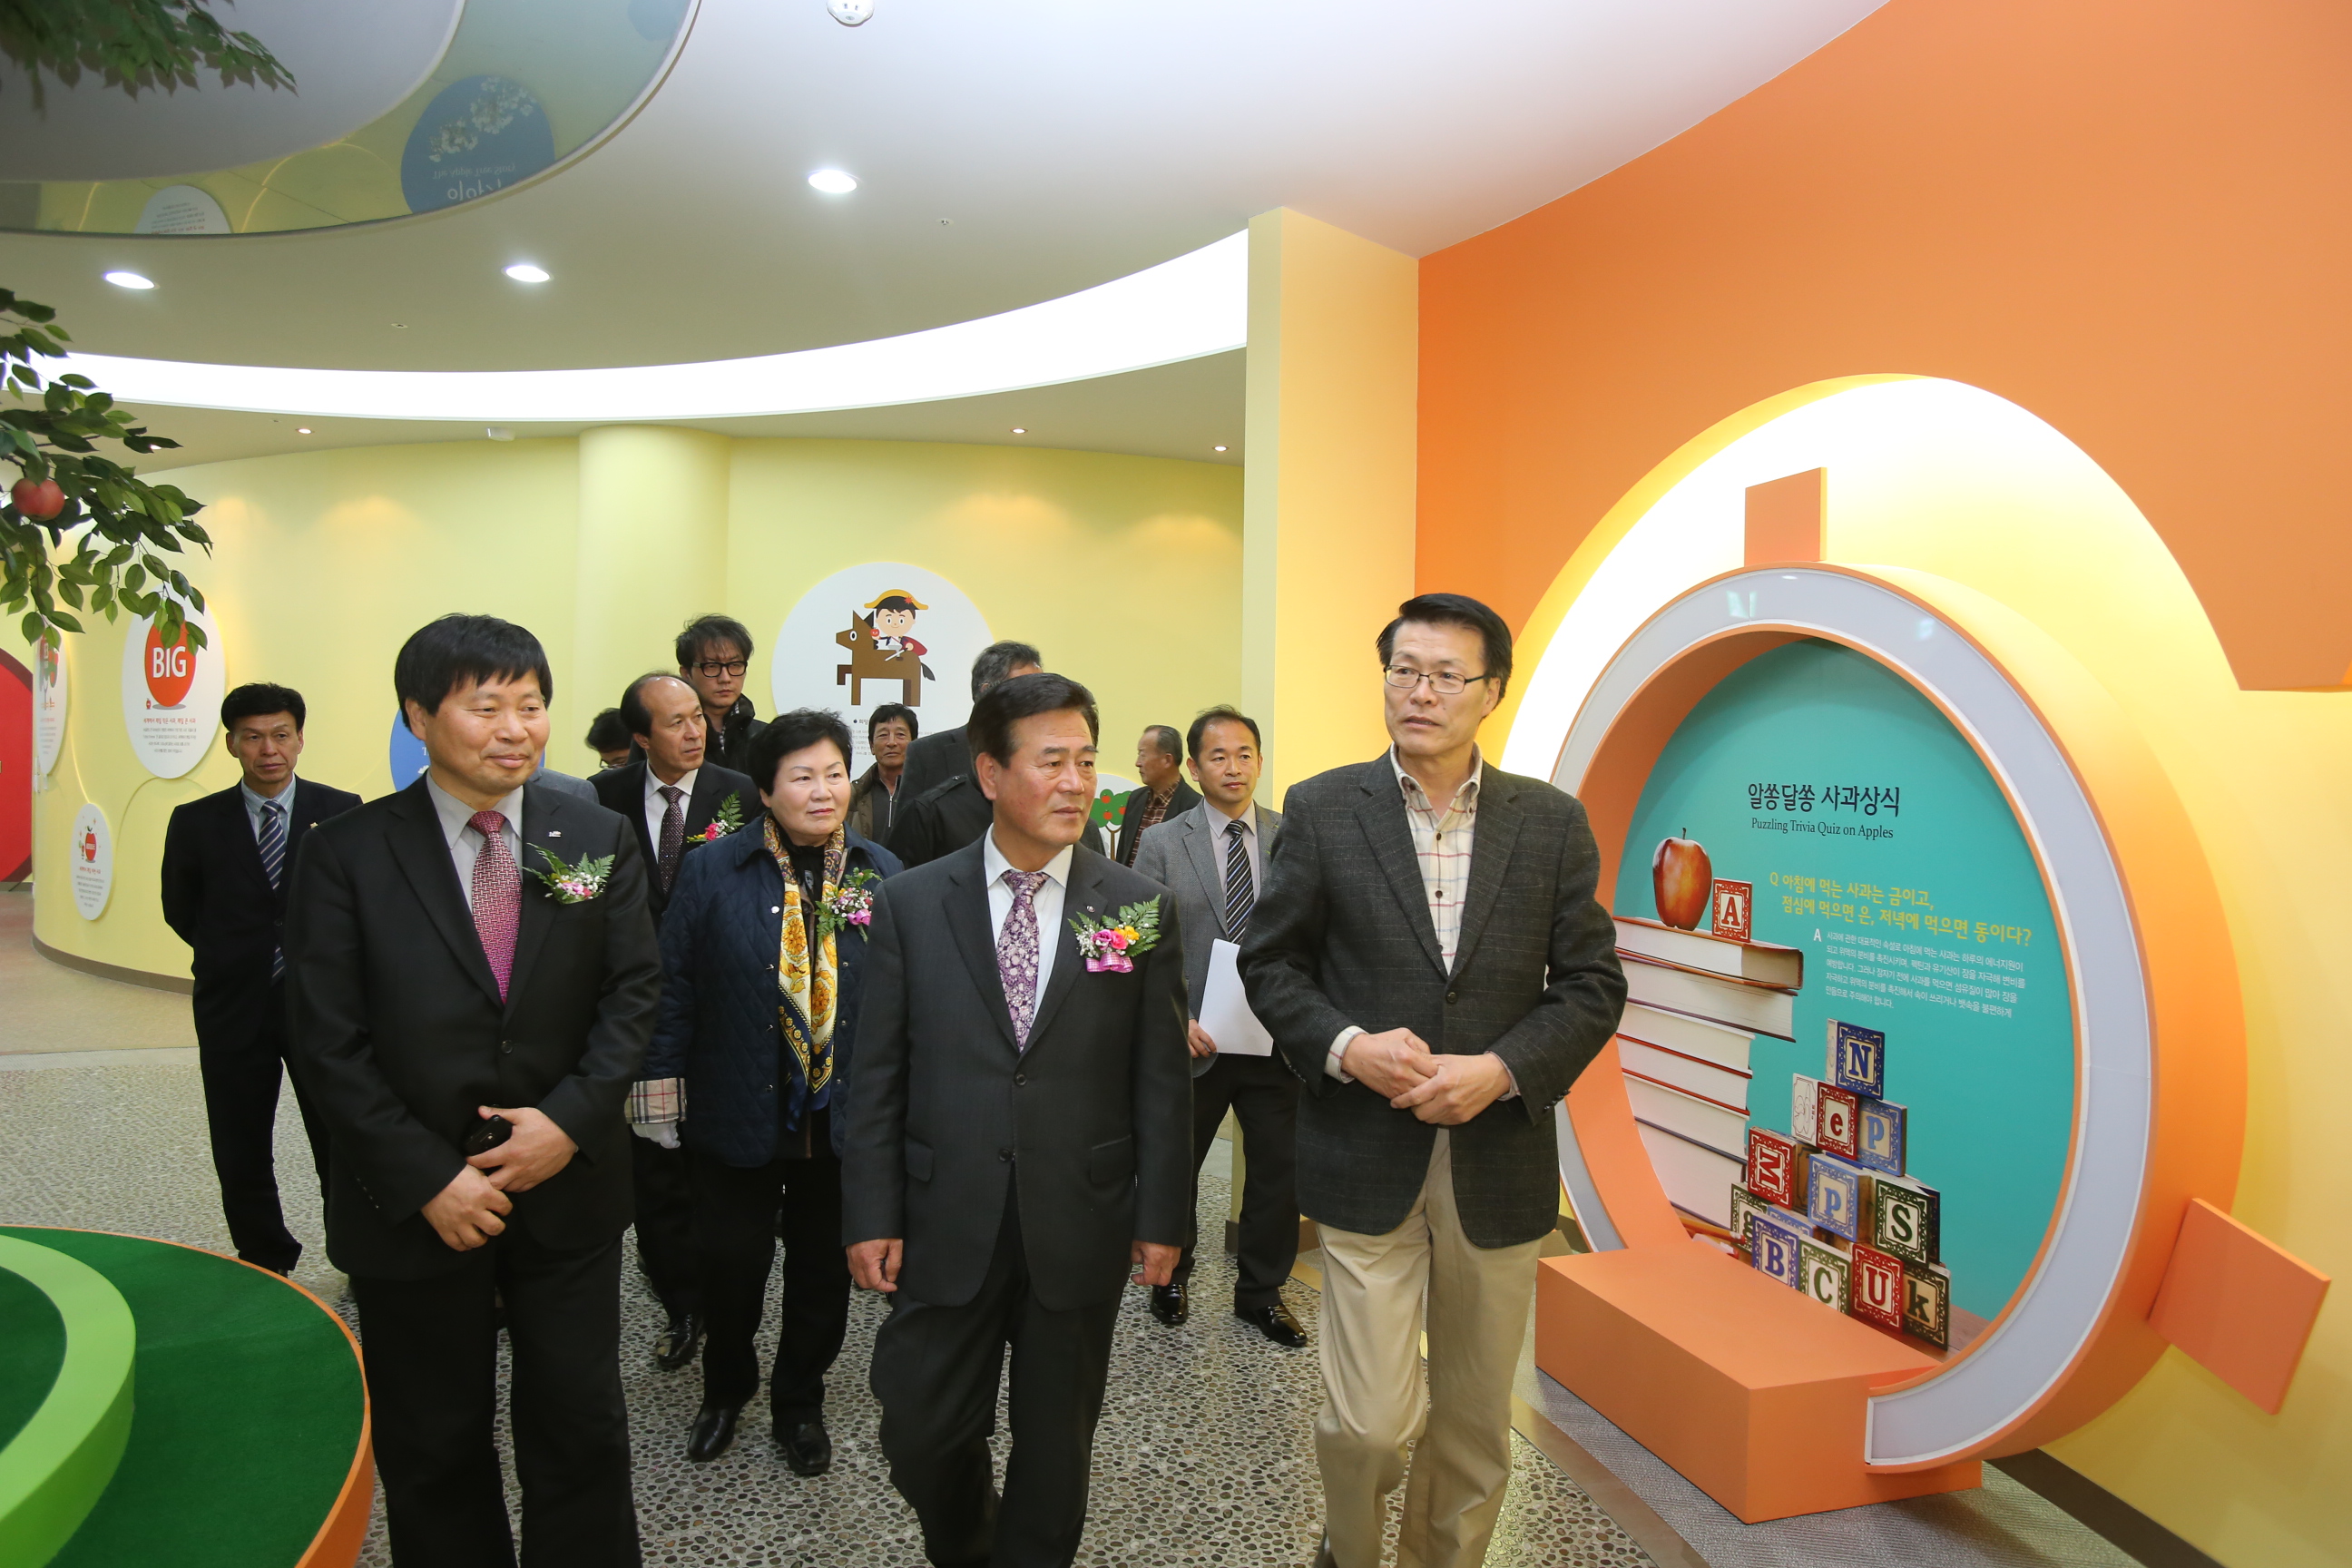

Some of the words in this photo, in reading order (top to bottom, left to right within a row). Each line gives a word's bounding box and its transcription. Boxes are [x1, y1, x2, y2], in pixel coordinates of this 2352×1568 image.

[152, 645, 187, 678] BIG
[1748, 783, 1816, 812] 알쏭달쏭
[1821, 785, 1900, 818] 사과상식
[1751, 818, 1788, 834] Puzzling
[1789, 820, 1816, 833] Trivia
[1818, 821, 1840, 837] Quiz
[1843, 826, 1856, 836] on
[1857, 824, 1894, 841] Apples
[1769, 872, 1779, 887] Q
[1782, 875, 1816, 894] 아침에
[1819, 878, 1843, 899] 먹는
[1847, 882, 1886, 905] 사과는
[1888, 887, 1935, 911] 금이고,
[1721, 897, 1740, 926] A
[1782, 896, 1815, 916] 점심에
[1818, 900, 1855, 923] 먹으면
[1857, 906, 1875, 926] 은,
[1879, 908, 1920, 930] 저녁에
[1925, 915, 1969, 940] 먹으면
[1974, 921, 2033, 946] 동이다?
[1813, 928, 1822, 942] A
[1827, 931, 1844, 942] 사과에
[1845, 934, 1857, 945] 관한
[1857, 936, 1882, 949] 대표적인
[1902, 944, 1923, 956] 아침에
[1924, 947, 1937, 958] 먹는
[1939, 950, 1960, 962] 사과는
[1962, 953, 1984, 965] 하루의
[1985, 957, 2024, 972] 에너지원이
[1827, 945, 1838, 955] 되고
[1839, 946, 1857, 958] 위액의
[1857, 951, 1875, 962] 분비를
[1932, 963, 1960, 977] 유기산이
[1962, 968, 1976, 980] 장을
[1978, 971, 2001, 984] 자극해
[2003, 976, 2025, 989] 변비를
[1826, 972, 1848, 984] 자극하고
[1849, 976, 1867, 988] 위액의
[1868, 981, 1886, 993] 분비를
[1915, 990, 1928, 1001] 속이
[1929, 994, 1956, 1006] 쓰리거나
[1958, 999, 1980, 1012] 뱃속을
[1982, 1003, 2013, 1018] 불편하게
[1849, 990, 1873, 1004] 주의해야
[1874, 995, 1895, 1008] 합니다.
[1857, 965, 1876, 975] 그러나
[1877, 967, 1895, 980] 잠자기
[1896, 972, 1909, 983] 전에
[1910, 975, 1931, 987] 사과를
[1932, 978, 1953, 991] 먹으면
[1955, 983, 1984, 996] 섬유질이
[1985, 988, 2000, 1000] 많아
[2002, 991, 2017, 1004] 장을
[1849, 1041, 1871, 1079] N
[1830, 1112, 1844, 1136] e
[1891, 1203, 1913, 1243] S
[1765, 1237, 1785, 1277] B
[1814, 1267, 1833, 1304] C
[1867, 1268, 1889, 1307] U
